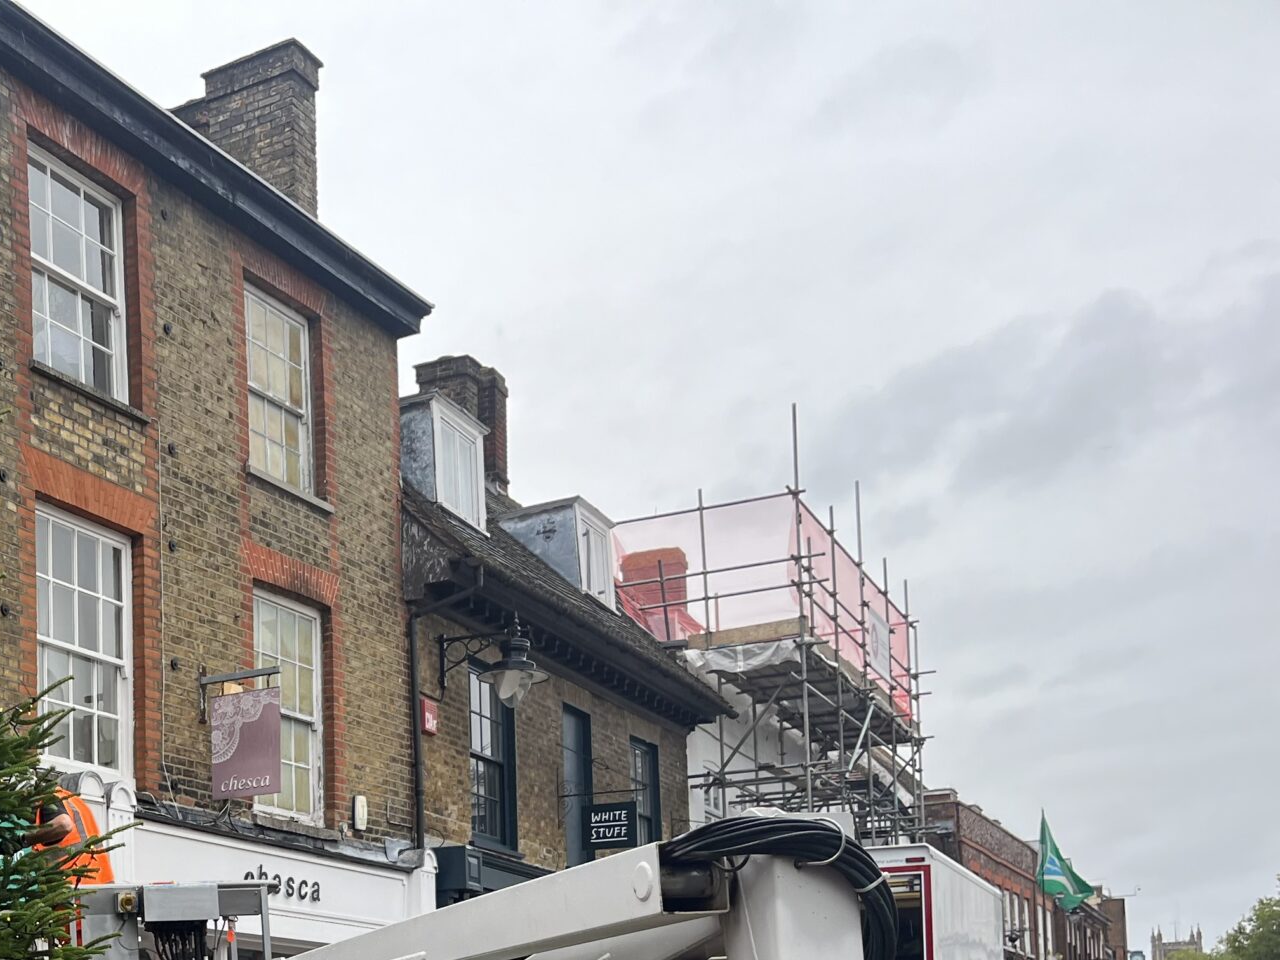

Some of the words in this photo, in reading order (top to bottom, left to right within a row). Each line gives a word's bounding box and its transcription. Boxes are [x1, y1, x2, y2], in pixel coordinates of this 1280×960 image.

[221, 774, 270, 792] chesca
[591, 810, 628, 823] WHITE
[591, 826, 628, 839] STUFF
